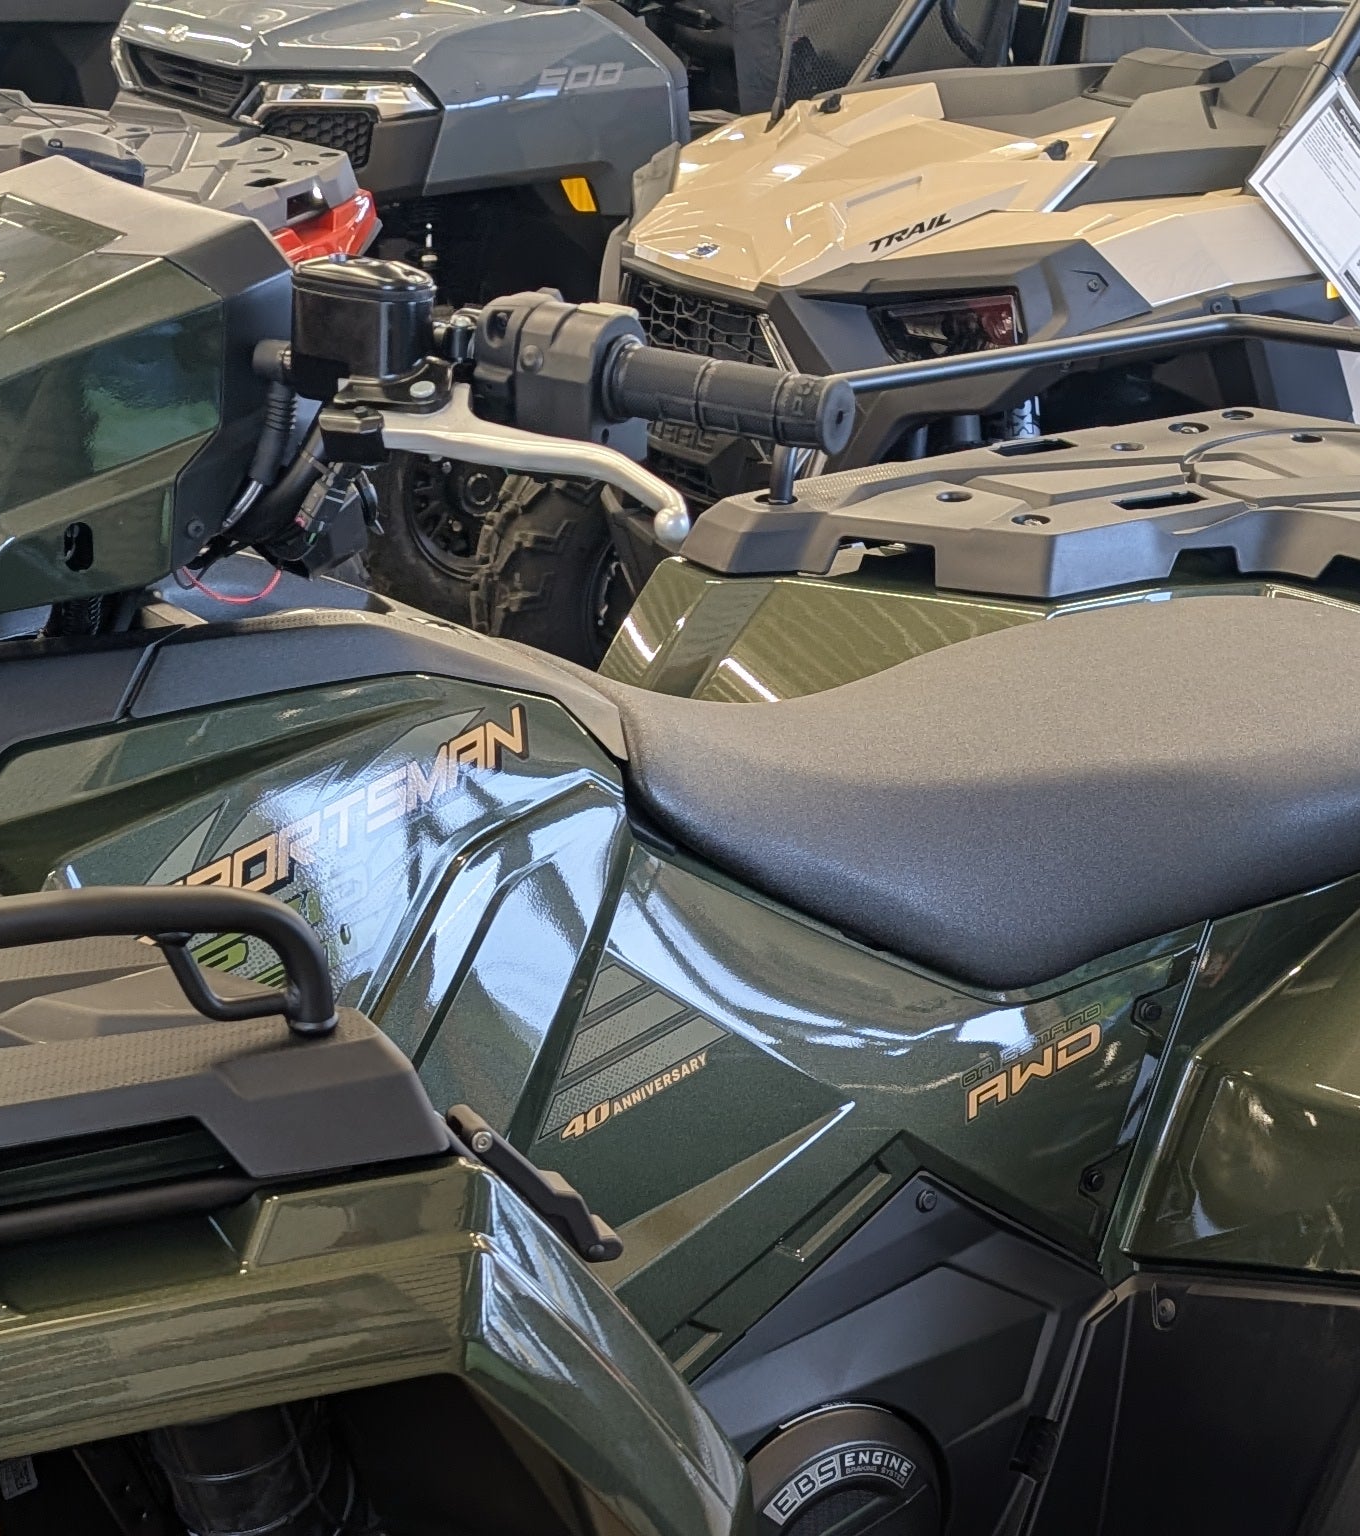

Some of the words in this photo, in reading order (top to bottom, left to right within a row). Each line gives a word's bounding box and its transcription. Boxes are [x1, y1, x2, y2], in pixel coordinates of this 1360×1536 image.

[537, 62, 625, 97] 500
[868, 212, 952, 253] TRAIL
[173, 698, 532, 900] PORTSMAN
[560, 1099, 612, 1141] 40
[612, 1051, 709, 1116] ANNIVERSARY
[966, 1021, 1103, 1123] AWD
[772, 1458, 838, 1518] EBS
[844, 1450, 913, 1478] ENGINE
[845, 1464, 879, 1475] BRAKING
